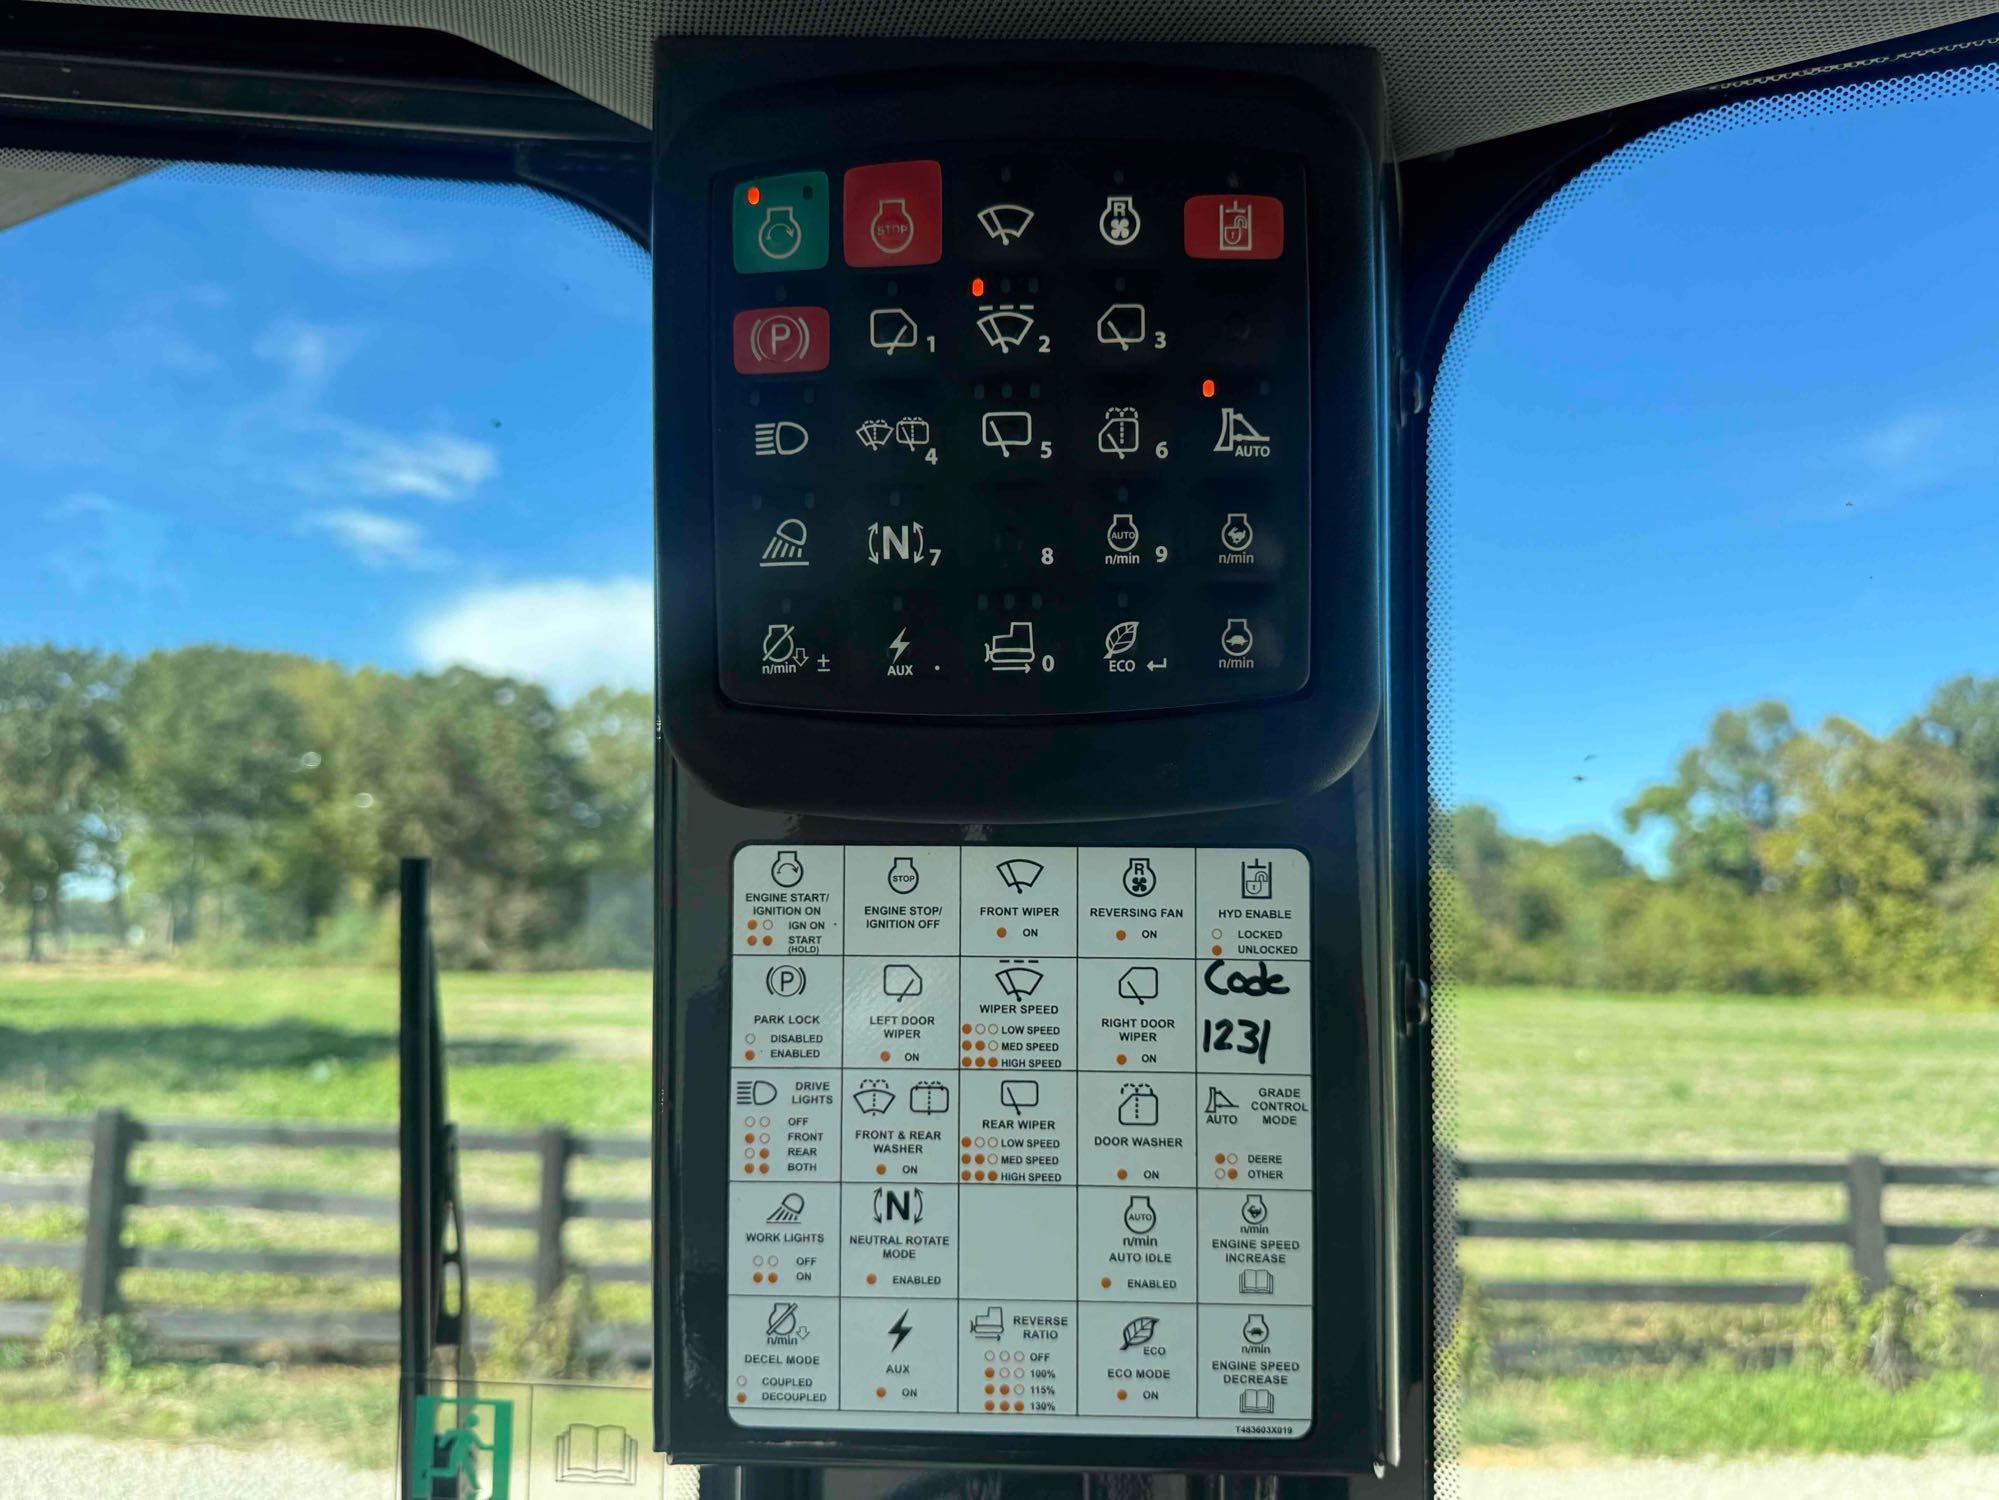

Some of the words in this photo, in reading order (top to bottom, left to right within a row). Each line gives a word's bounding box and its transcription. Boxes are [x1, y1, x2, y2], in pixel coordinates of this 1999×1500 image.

[1113, 202, 1126, 216] R
[877, 223, 909, 236] STOP
[770, 324, 791, 354] P
[1154, 332, 1166, 349] 3
[926, 336, 936, 352] 1
[1038, 336, 1051, 353] 2
[1040, 442, 1052, 459] 5
[1155, 442, 1168, 459] 6
[1235, 445, 1270, 458] AUTO
[925, 448, 938, 465] 4
[1111, 530, 1135, 541] AUTO
[883, 526, 909, 559] N
[930, 549, 941, 566] 7
[1041, 548, 1054, 565] 8
[1104, 551, 1140, 565] n/min
[1155, 546, 1168, 563] 9
[1219, 551, 1254, 564] n/min
[1042, 655, 1054, 673] 0
[1109, 659, 1135, 672] ECO
[1219, 656, 1254, 669] n/min
[762, 662, 797, 675] n/min
[887, 664, 913, 677] AUX
[1134, 864, 1144, 875] R
[746, 893, 787, 902] ENGINE
[790, 893, 829, 902] START/
[753, 907, 802, 915] IGNITION
[805, 907, 821, 915] ON
[865, 906, 906, 915] ENGINE
[910, 907, 942, 915] STOP/
[980, 907, 1018, 916] FRONT
[1022, 908, 1059, 916] WIPER
[1090, 908, 1157, 917] REVERSING
[1161, 909, 1183, 917] FAN
[1218, 910, 1242, 918] HYD
[1246, 910, 1292, 919] ENABLE
[789, 922, 807, 930] IGN
[866, 920, 915, 929] IGNITION
[918, 920, 940, 929] OFF
[1023, 929, 1038, 937] ON
[1142, 930, 1157, 938] ON
[1238, 931, 1282, 939] LOCKED
[788, 936, 822, 944] START
[788, 946, 819, 954] (HOLD)
[1238, 946, 1298, 954] UNLOCKED
[781, 972, 794, 991] P
[1204, 959, 1290, 996] Code
[980, 1005, 1017, 1013] WIPER
[1020, 1005, 1059, 1014] SPEED
[754, 1015, 784, 1024] PARK
[789, 1016, 820, 1024] LOCK
[870, 1016, 898, 1025] LEFT
[902, 1017, 935, 1025] DOOR
[1102, 1019, 1137, 1028] RIGHT
[1141, 1019, 1175, 1028] DOOR
[884, 1029, 920, 1038] WIPER
[1002, 1026, 1023, 1035] LOW
[1027, 1026, 1060, 1035] SPEED
[771, 1035, 823, 1043] DISABLED
[1119, 1032, 1157, 1041] WIPER
[1203, 1019, 1271, 1064] 1231
[1002, 1043, 1022, 1051] MED
[1026, 1043, 1059, 1051] SPEED
[771, 1050, 820, 1058] ENABLED
[905, 1053, 919, 1061] ON
[1142, 1054, 1156, 1063] ON
[1002, 1059, 1025, 1068] HIGH
[1028, 1059, 1062, 1068] SPEED
[796, 1082, 830, 1090] DRIVE
[1259, 1088, 1300, 1098] GRADE
[792, 1096, 833, 1104] LIGHTS
[1251, 1102, 1308, 1111] CONTROL
[788, 1117, 808, 1126] OFF
[1206, 1115, 1237, 1124] AUTO
[1263, 1116, 1297, 1125] MODE
[982, 1120, 1014, 1129] REAR
[1018, 1120, 1055, 1129] WIPER
[788, 1133, 823, 1141] FRONT
[856, 1130, 894, 1140] FRONT
[898, 1131, 906, 1139] &
[910, 1131, 941, 1140] REAR
[1001, 1139, 1023, 1148] LOW
[1027, 1139, 1060, 1148] SPEED
[1095, 1137, 1128, 1146] DOOR
[1132, 1137, 1183, 1147] WASHER
[788, 1148, 817, 1156] REAR
[873, 1144, 923, 1153] WASHER
[1001, 1156, 1022, 1164] MED
[1026, 1156, 1059, 1165] SPEED
[1248, 1155, 1282, 1164] DEERE
[788, 1163, 817, 1171] BOTH
[902, 1165, 918, 1174] ON
[1001, 1172, 1025, 1181] HIGH
[1028, 1173, 1062, 1182] SPEED
[1144, 1171, 1159, 1179] ON
[1248, 1170, 1283, 1179] OTHER
[887, 1191, 910, 1221] N
[1240, 1225, 1268, 1234] n/min
[746, 1233, 781, 1242] WORK
[784, 1233, 824, 1243] LIGHTS
[850, 1235, 902, 1245] NEUTRAL
[906, 1236, 949, 1245] ROTATE
[1123, 1236, 1157, 1246] n/min
[1212, 1239, 1256, 1249] ENGINE
[1260, 1240, 1300, 1250] SPEED
[883, 1249, 916, 1259] MODE
[1109, 1253, 1141, 1262] AUTO
[1146, 1253, 1171, 1263] IDLE
[1226, 1253, 1286, 1263] INCREASE
[796, 1257, 817, 1266] OFF
[796, 1272, 811, 1280] ON
[893, 1276, 941, 1285] ENABLED
[1128, 1279, 1177, 1289] ENABLED
[1013, 1316, 1068, 1326] REVERSE
[1023, 1330, 1058, 1339] RATIO
[767, 1336, 798, 1345] n/min
[1143, 1347, 1166, 1355] ECO
[1242, 1345, 1270, 1354] n/min
[745, 1355, 782, 1364] DECEL
[786, 1355, 820, 1365] MODE
[1030, 1353, 1050, 1362] OFF
[886, 1365, 910, 1374] AUX
[1212, 1361, 1256, 1371] ENGINE
[1260, 1362, 1299, 1371] SPEED
[1031, 1370, 1055, 1378] 100%
[1108, 1369, 1132, 1378] ECO
[1136, 1369, 1170, 1379] MODE
[762, 1378, 813, 1387] COUPLED
[1223, 1375, 1288, 1384] DECREASE
[902, 1388, 917, 1397] ON
[1031, 1386, 1055, 1395] 115%
[762, 1392, 827, 1402] DECOUPLED
[1143, 1391, 1158, 1400] ON
[1031, 1402, 1055, 1411] 130%
